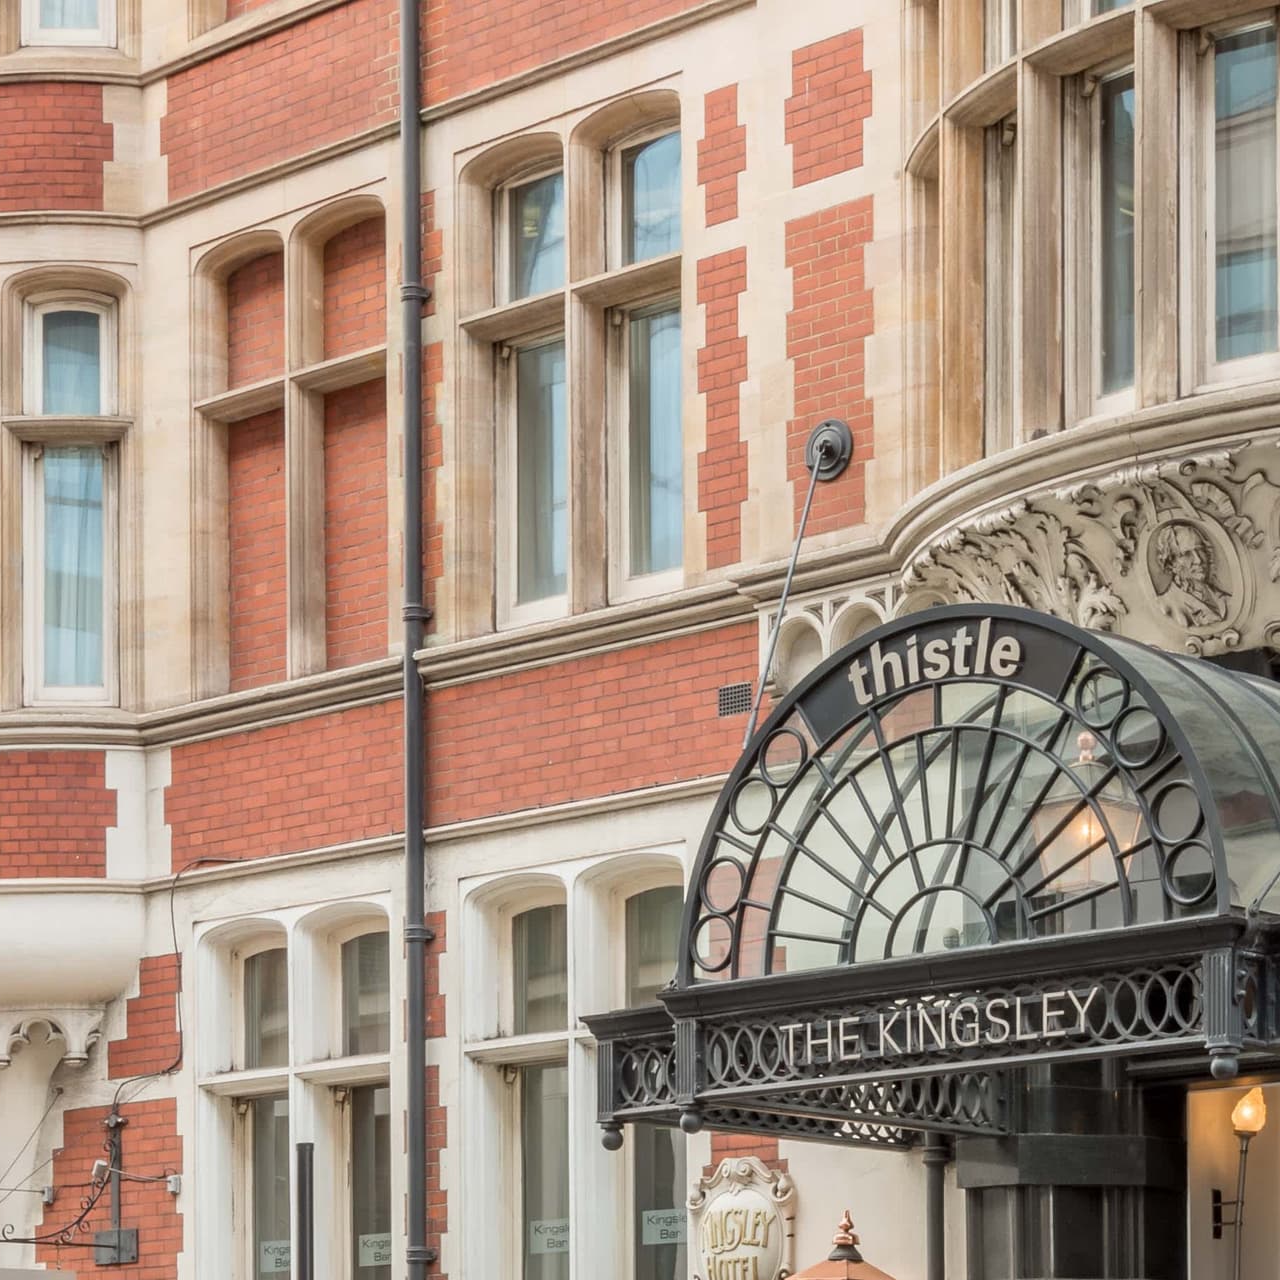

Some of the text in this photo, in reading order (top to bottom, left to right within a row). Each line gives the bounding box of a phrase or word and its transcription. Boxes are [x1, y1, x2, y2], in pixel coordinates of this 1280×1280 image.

[848, 617, 1021, 705] thistle
[779, 986, 1099, 1066] THE KINGSLEY
[647, 1214, 687, 1227] Kingsle
[660, 1229, 681, 1240] Bar
[700, 1207, 778, 1255] KINGSLEY
